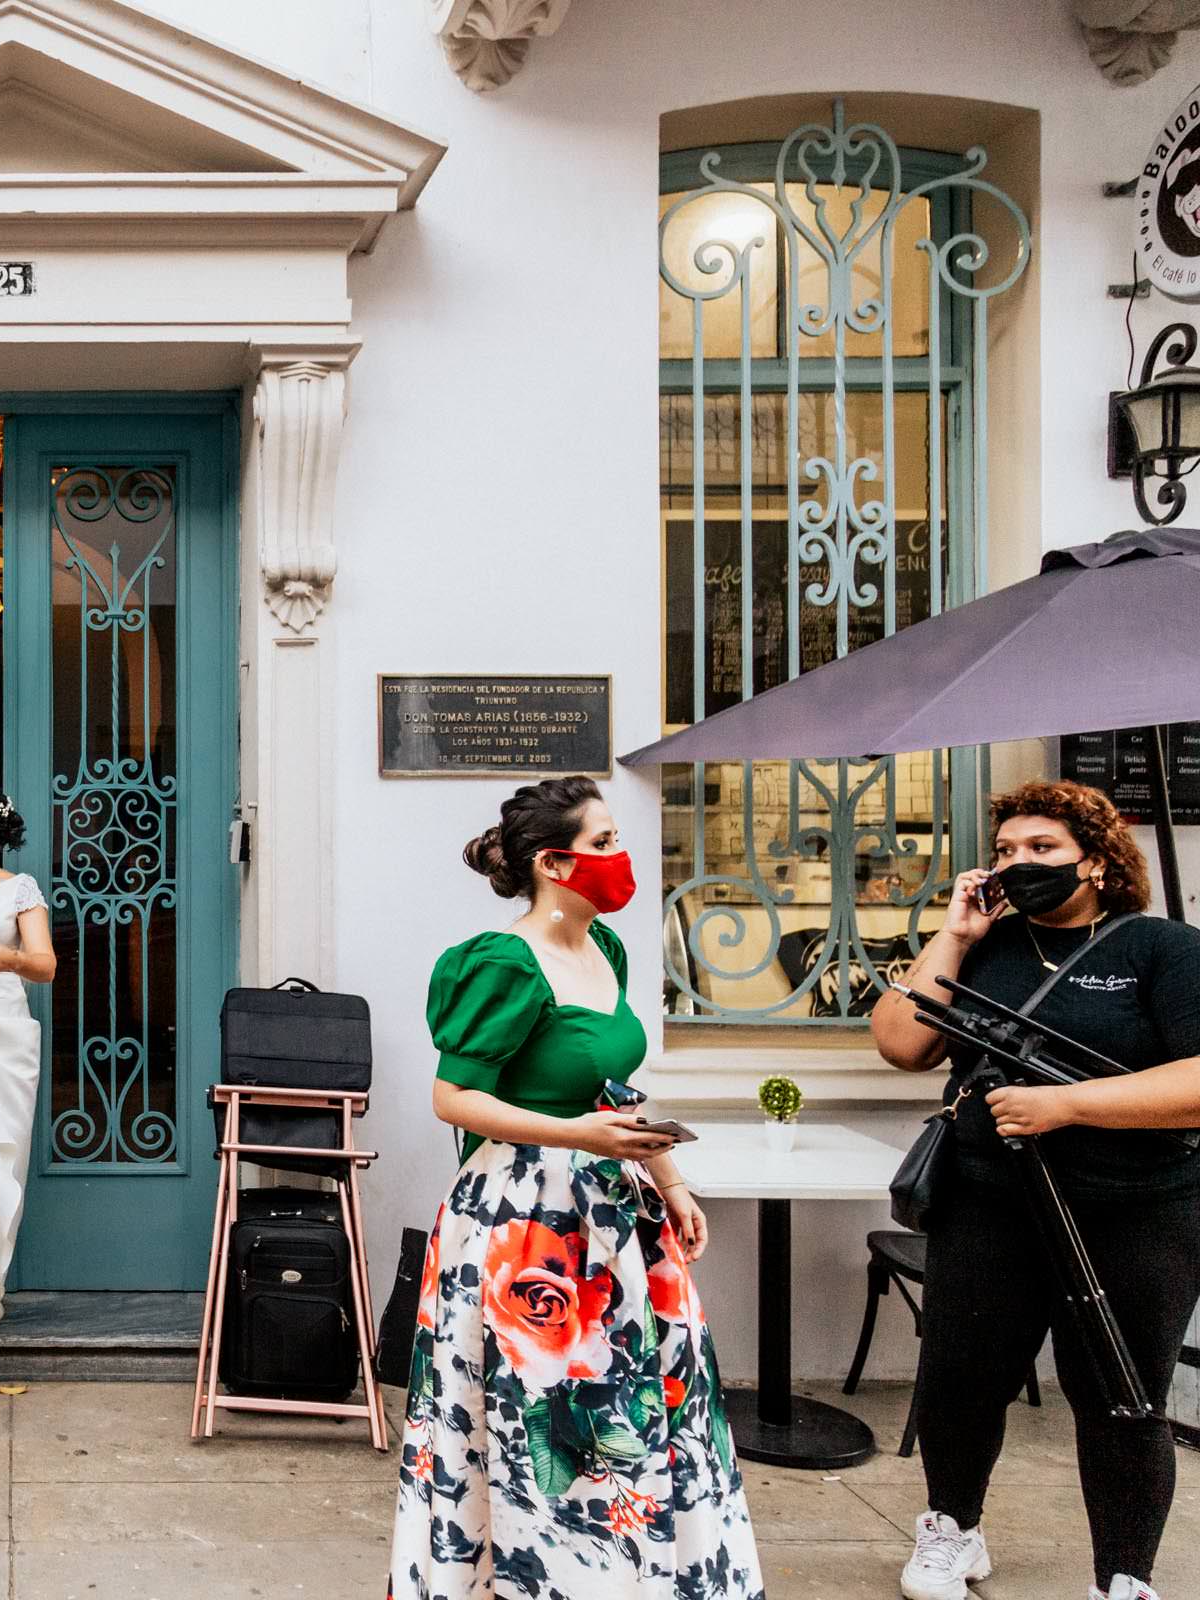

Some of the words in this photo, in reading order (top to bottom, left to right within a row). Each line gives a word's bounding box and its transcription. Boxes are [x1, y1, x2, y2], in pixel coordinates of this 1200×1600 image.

[420, 685, 430, 694] LA
[432, 685, 474, 694] RESIDENCIA
[477, 685, 490, 694] DEL
[492, 685, 530, 694] FUNDADOR
[532, 685, 542, 694] DE
[544, 685, 554, 694] LA
[556, 685, 598, 694] REPUBLICA
[600, 685, 605, 694] Y
[404, 712, 428, 723] DON
[434, 712, 471, 723] TOMAS
[475, 712, 511, 723] ARIAS
[412, 726, 436, 734] QUIEN
[440, 726, 450, 734] LA
[453, 726, 498, 734] CONSTRUYO
[502, 726, 507, 734] Y
[510, 726, 537, 734] HABITO
[541, 726, 577, 734] DURANTE
[452, 738, 468, 746] LOS
[471, 736, 492, 746] AÑOS
[464, 755, 513, 763] SEPTIEMBRE
[515, 755, 525, 763] DE
